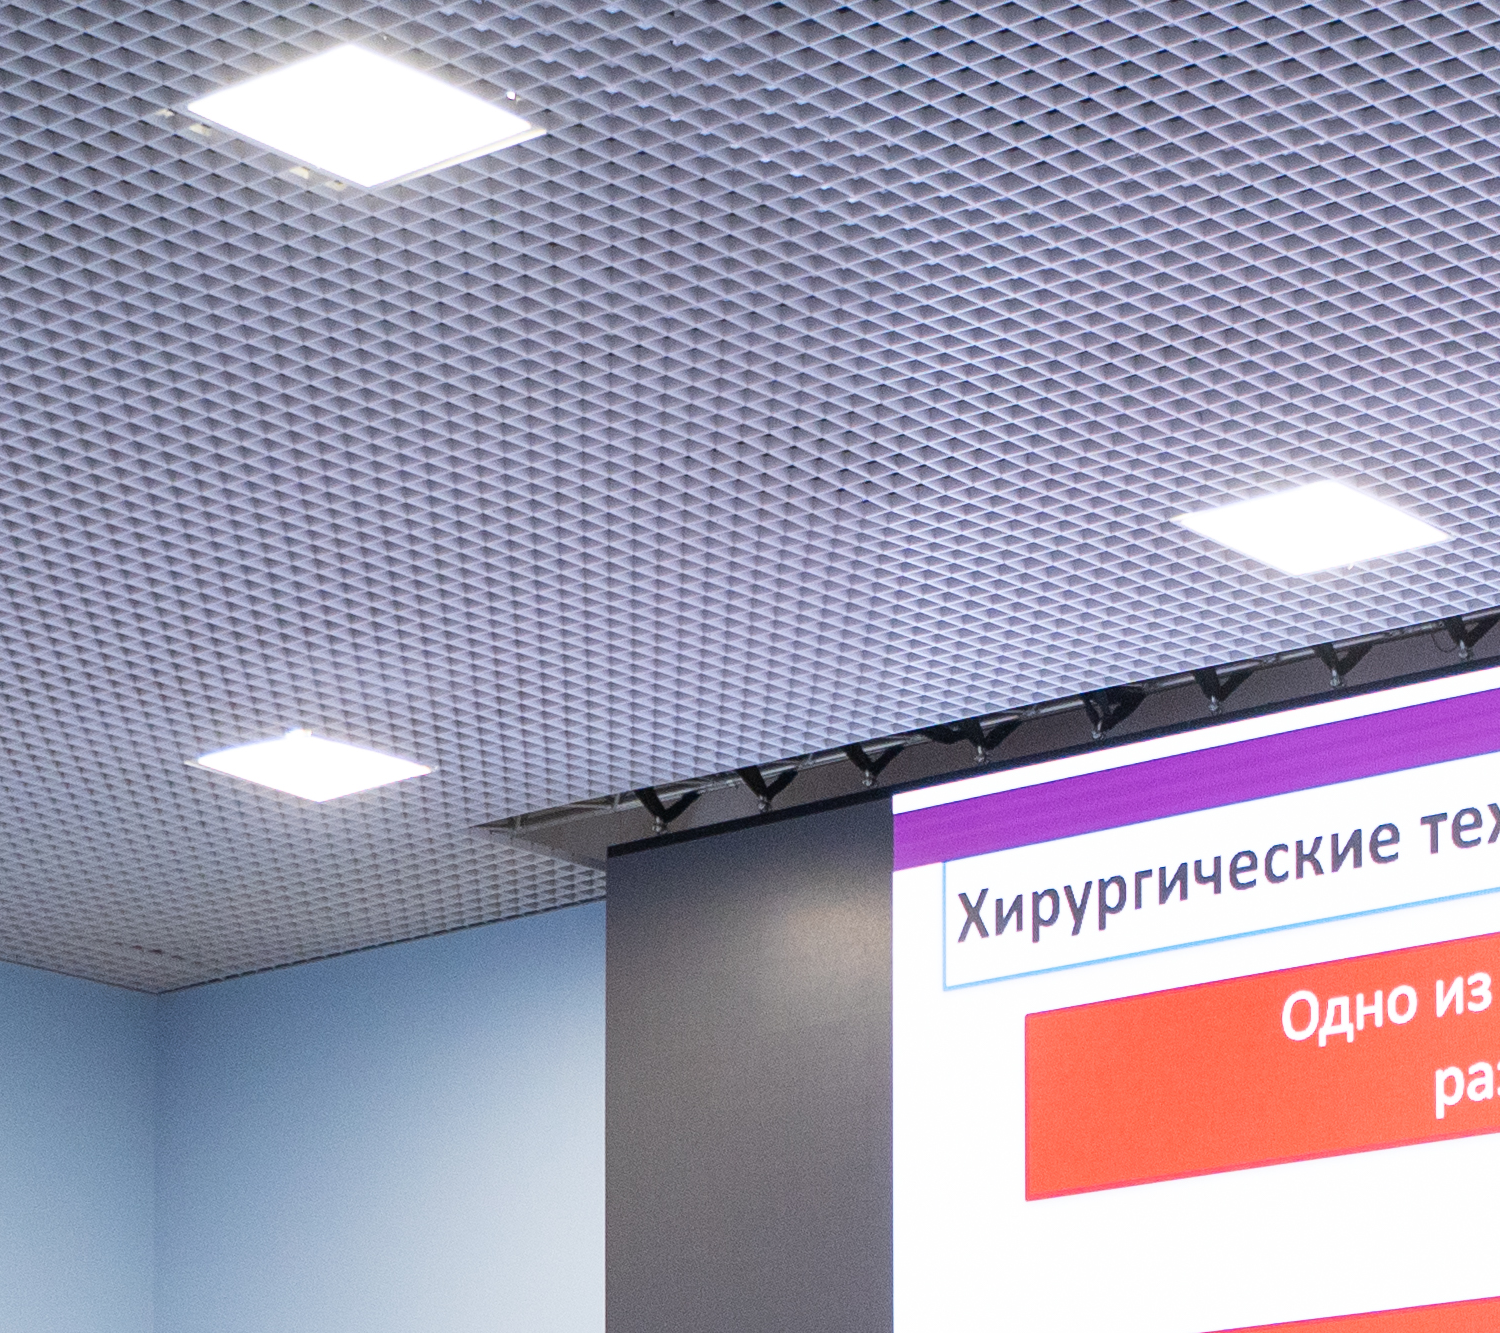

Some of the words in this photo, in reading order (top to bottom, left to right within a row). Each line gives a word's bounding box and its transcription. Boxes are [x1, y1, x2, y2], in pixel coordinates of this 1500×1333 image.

[957, 822, 1401, 943] Хирургические
[1281, 983, 1418, 1048] Одно
[1435, 971, 1493, 1019] из
